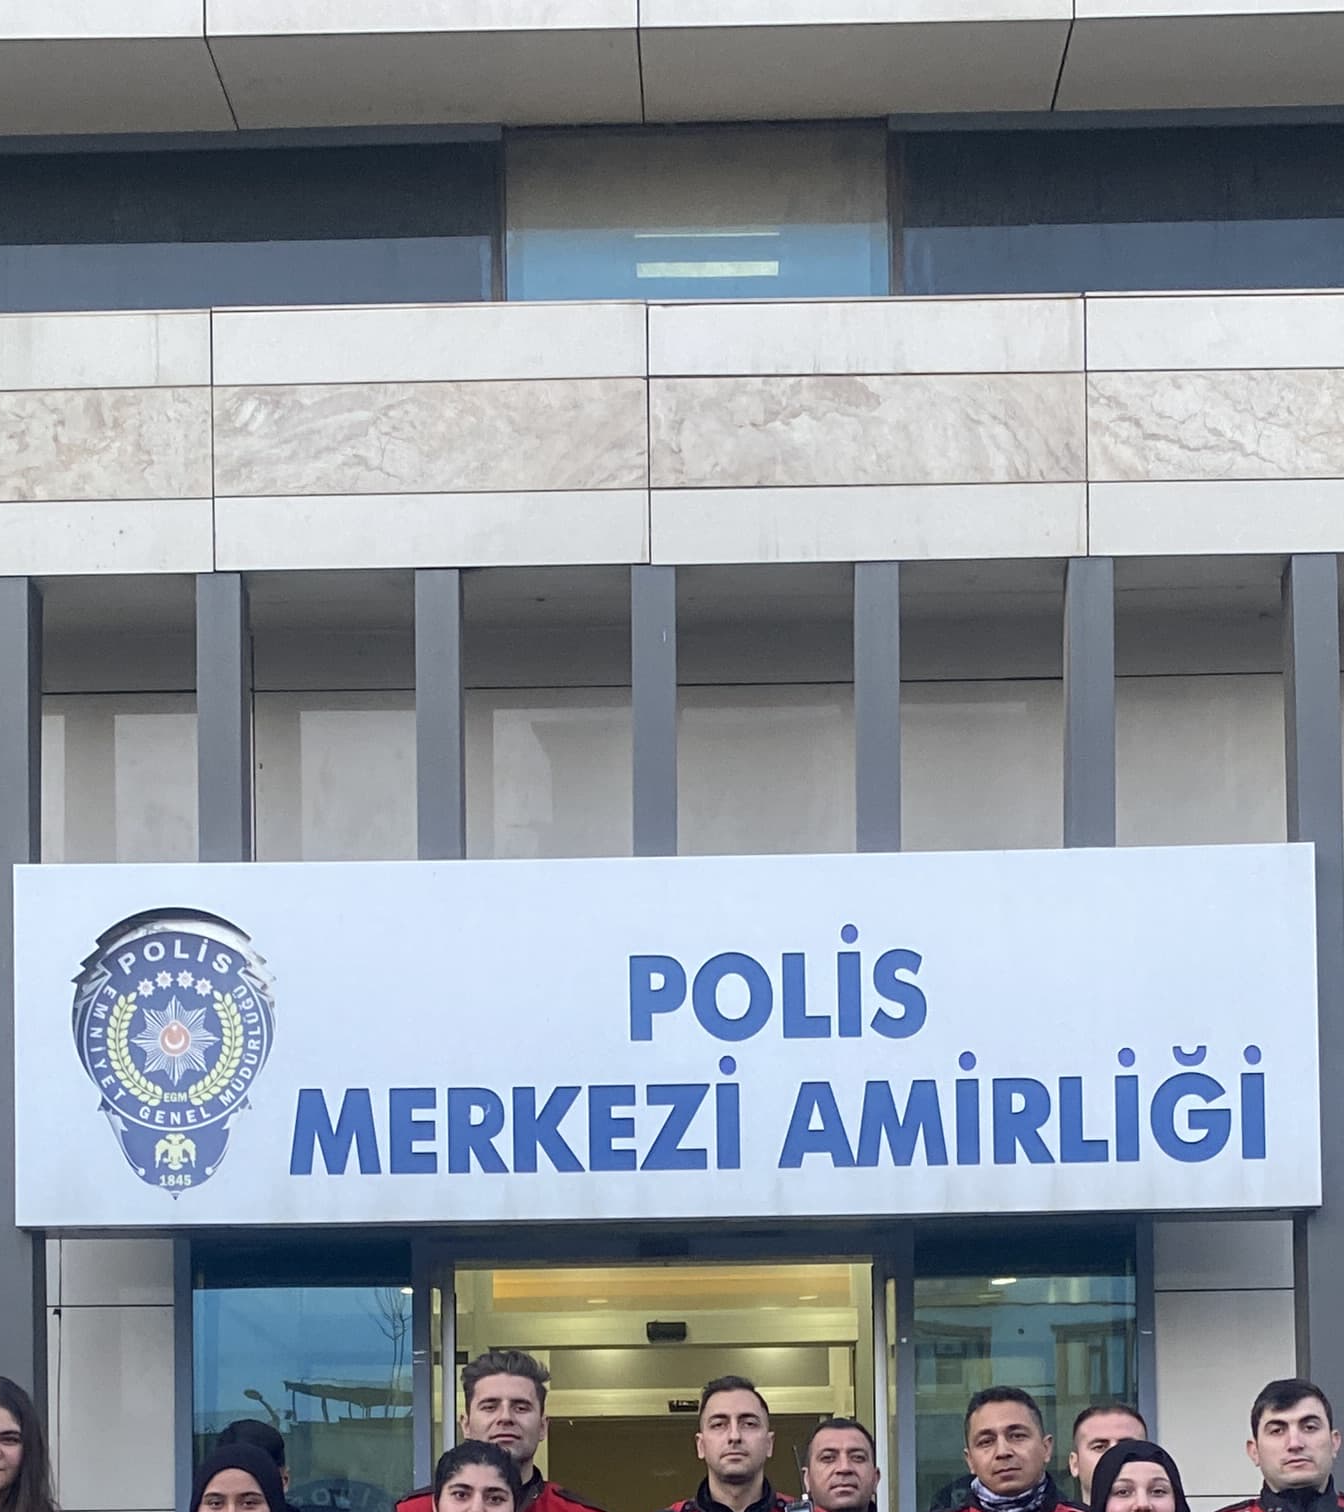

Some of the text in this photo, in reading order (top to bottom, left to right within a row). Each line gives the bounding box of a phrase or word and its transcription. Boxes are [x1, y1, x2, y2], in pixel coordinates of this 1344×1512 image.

[118, 938, 232, 975] POLİS
[629, 924, 927, 1041] POLİS
[163, 1092, 188, 1103] EGM
[289, 1045, 1266, 1176] MERKEZİ AMİRLİĞİ
[138, 1106, 211, 1125] GENEL
[159, 1174, 192, 1186] 1845
